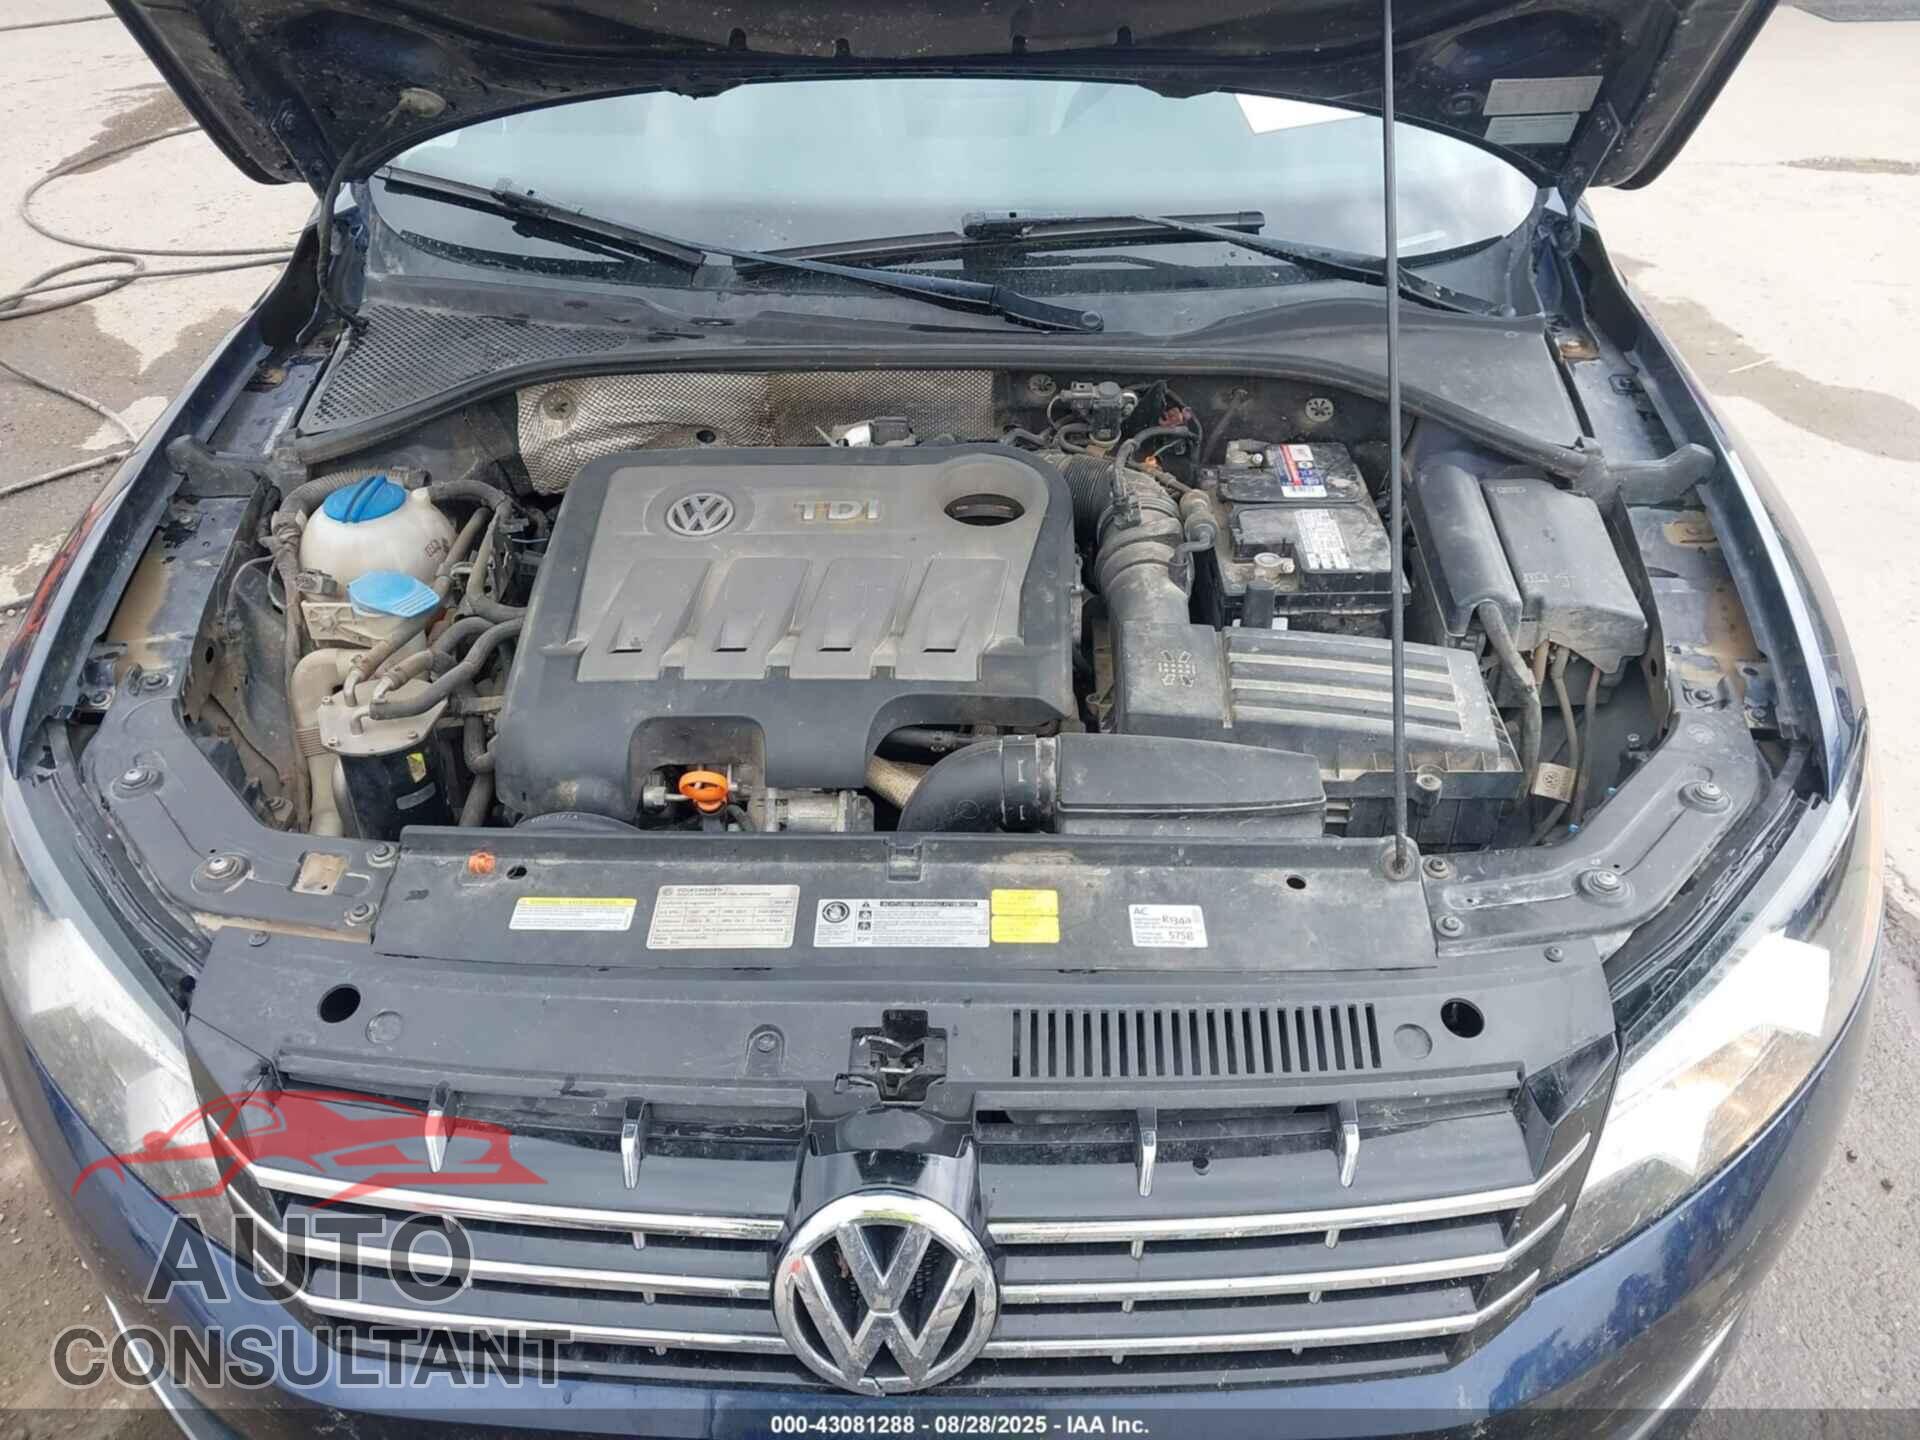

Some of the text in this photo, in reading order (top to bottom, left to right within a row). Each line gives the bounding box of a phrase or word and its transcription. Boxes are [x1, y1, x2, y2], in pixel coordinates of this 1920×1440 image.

[670, 495, 731, 532] VW
[793, 498, 881, 521] TDI
[780, 1208, 992, 1391] VW
